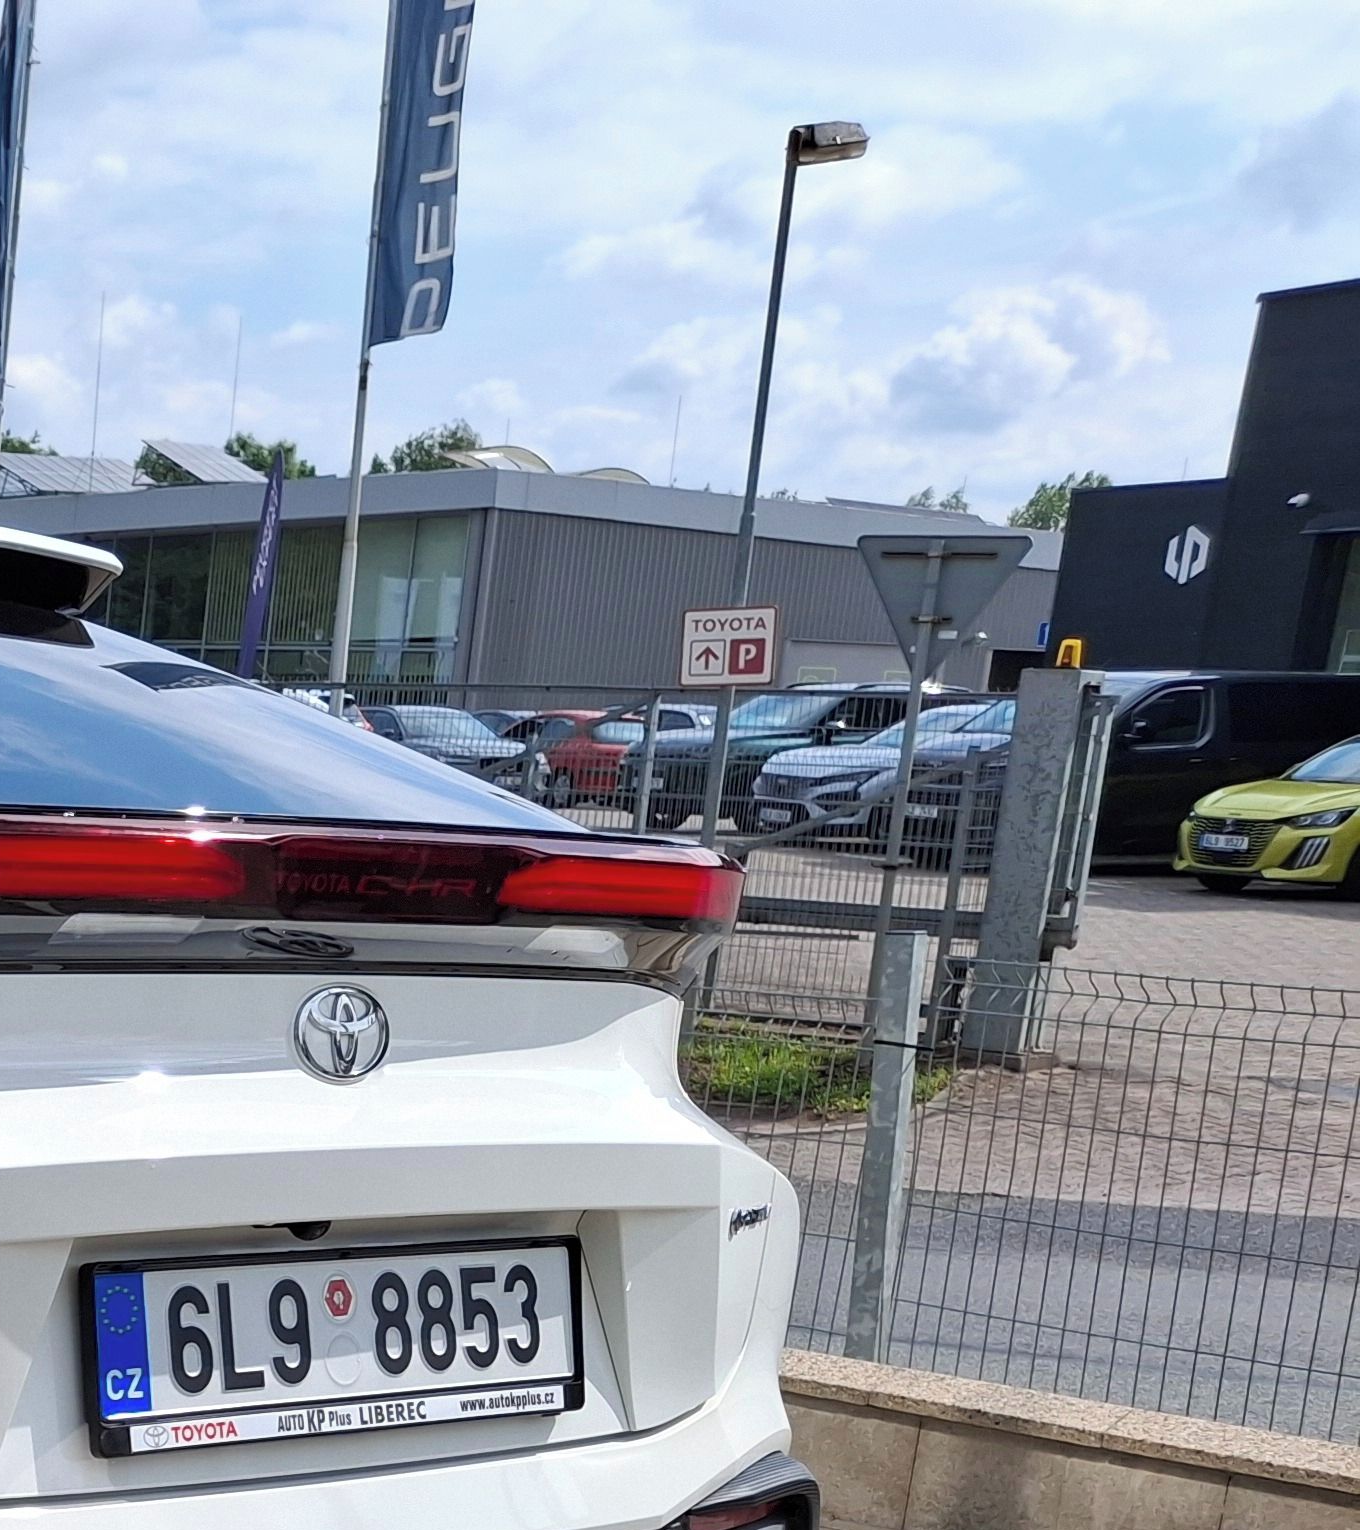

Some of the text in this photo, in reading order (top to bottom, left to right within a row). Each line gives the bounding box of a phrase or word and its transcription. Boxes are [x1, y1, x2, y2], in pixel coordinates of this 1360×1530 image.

[399, 0, 475, 338] PEUG
[691, 616, 767, 633] TOYOTA
[738, 643, 757, 670] P
[274, 872, 351, 894] TOYOTA
[167, 1264, 540, 1394] 6L9 8853
[105, 1367, 145, 1401] CZ
[171, 1390, 555, 1443] TOYOTA AUTO KP Plus LIBEREC www.autokpplus.cz
